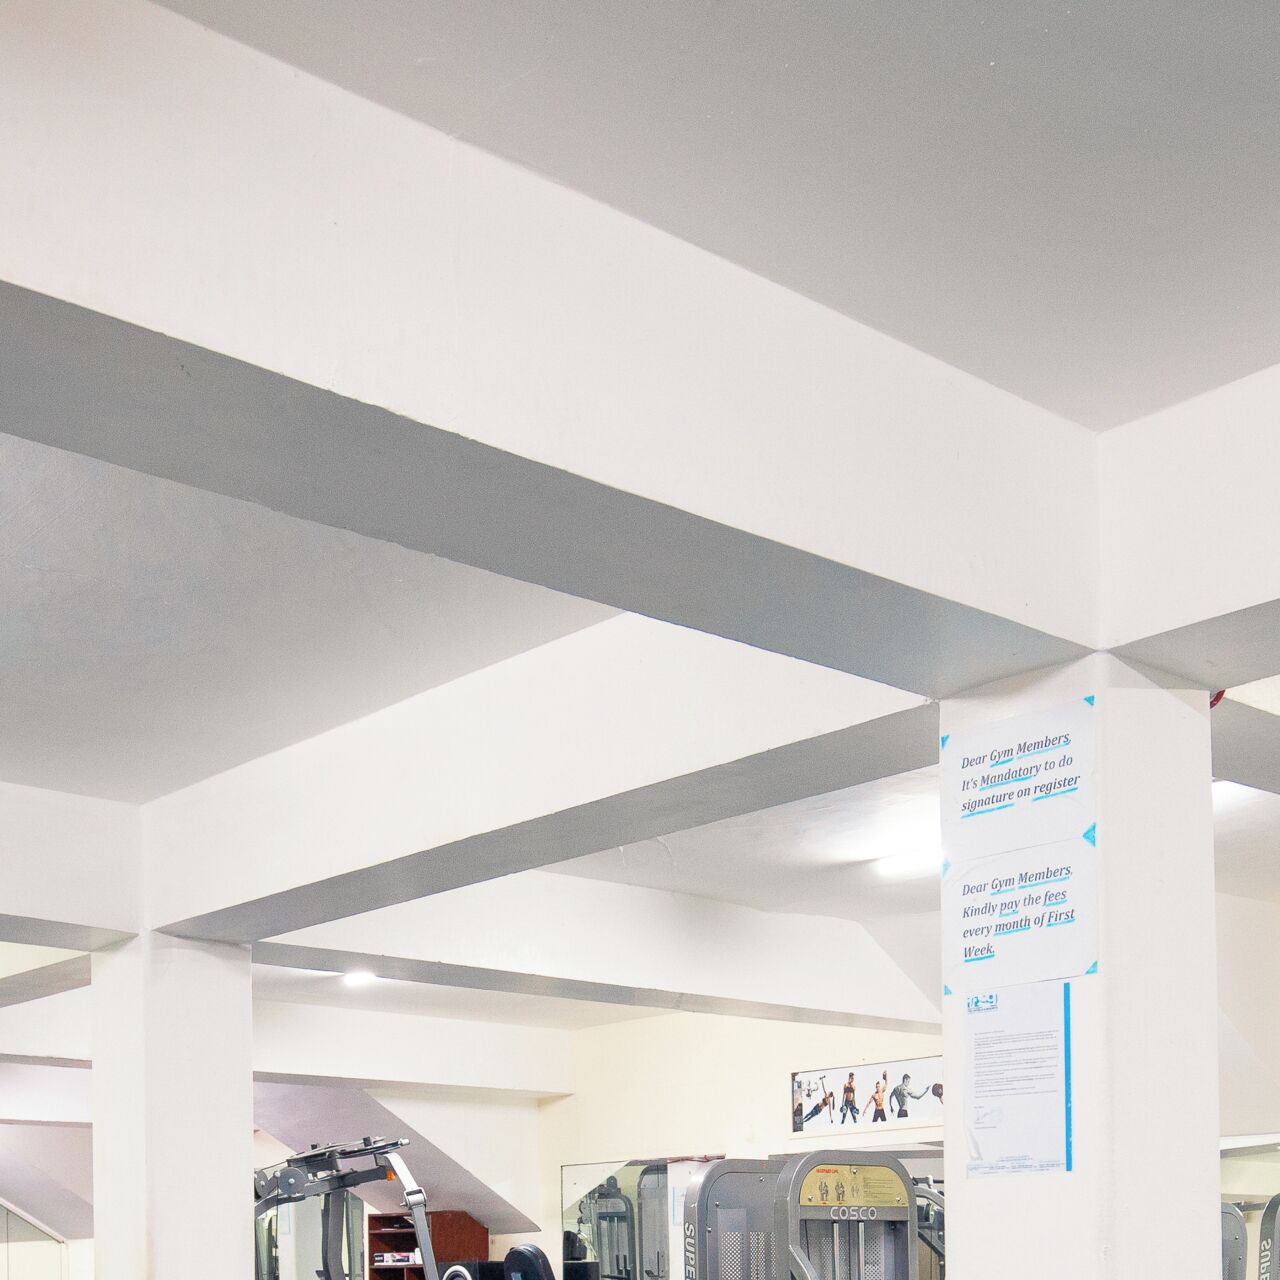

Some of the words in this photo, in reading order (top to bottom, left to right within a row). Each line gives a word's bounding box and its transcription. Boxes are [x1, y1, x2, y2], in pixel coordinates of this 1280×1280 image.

[961, 754, 987, 769] Dear
[990, 747, 1014, 763] Gym
[961, 777, 978, 791] It's
[980, 764, 1041, 787] Mandatory
[1044, 761, 1056, 771] to
[1058, 754, 1073, 768] do
[961, 791, 1014, 812] signature
[1016, 786, 1031, 798] on
[1033, 776, 1080, 795] register
[962, 882, 988, 896] Dear
[991, 877, 1015, 892] Gym
[962, 901, 998, 919] Kindly
[999, 899, 1020, 915] pay
[1023, 894, 1041, 907] the
[1042, 890, 1067, 906] fees
[962, 924, 993, 938] every
[994, 915, 1031, 932] month
[1033, 912, 1048, 928] of
[1047, 908, 1075, 923] First
[830, 1206, 877, 1220] COSCO
